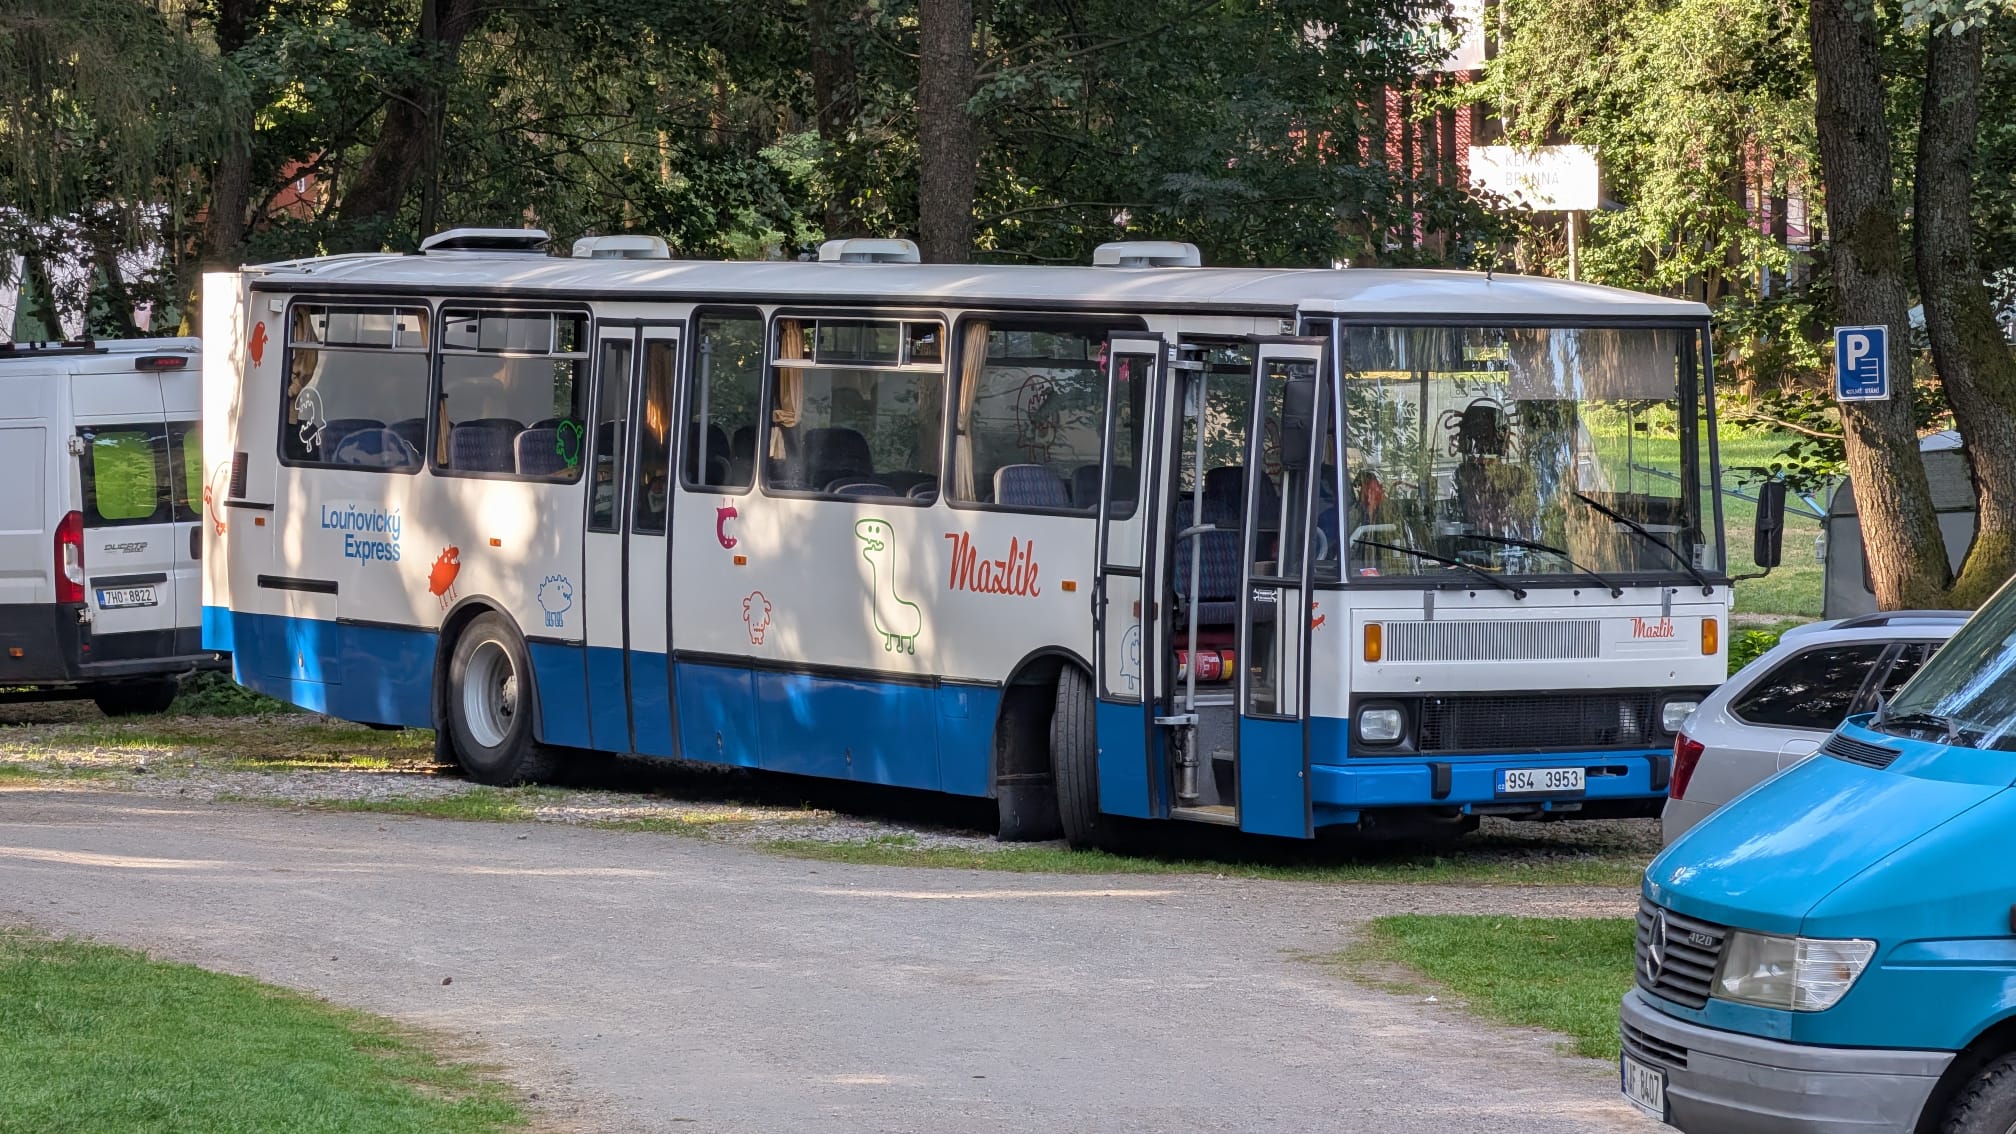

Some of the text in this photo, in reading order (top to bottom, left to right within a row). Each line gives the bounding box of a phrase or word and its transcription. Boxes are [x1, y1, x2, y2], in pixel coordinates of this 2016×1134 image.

[1847, 334, 1870, 371] P
[322, 504, 400, 541] Louňovický
[345, 534, 400, 566] Express
[945, 531, 1040, 597] Mazlik
[129, 589, 152, 602] 8822
[1630, 617, 1675, 638] Mazlik
[1509, 772, 1535, 789] 9S4
[1545, 771, 1578, 788] 3953
[1640, 1069, 1660, 1107] 8407
